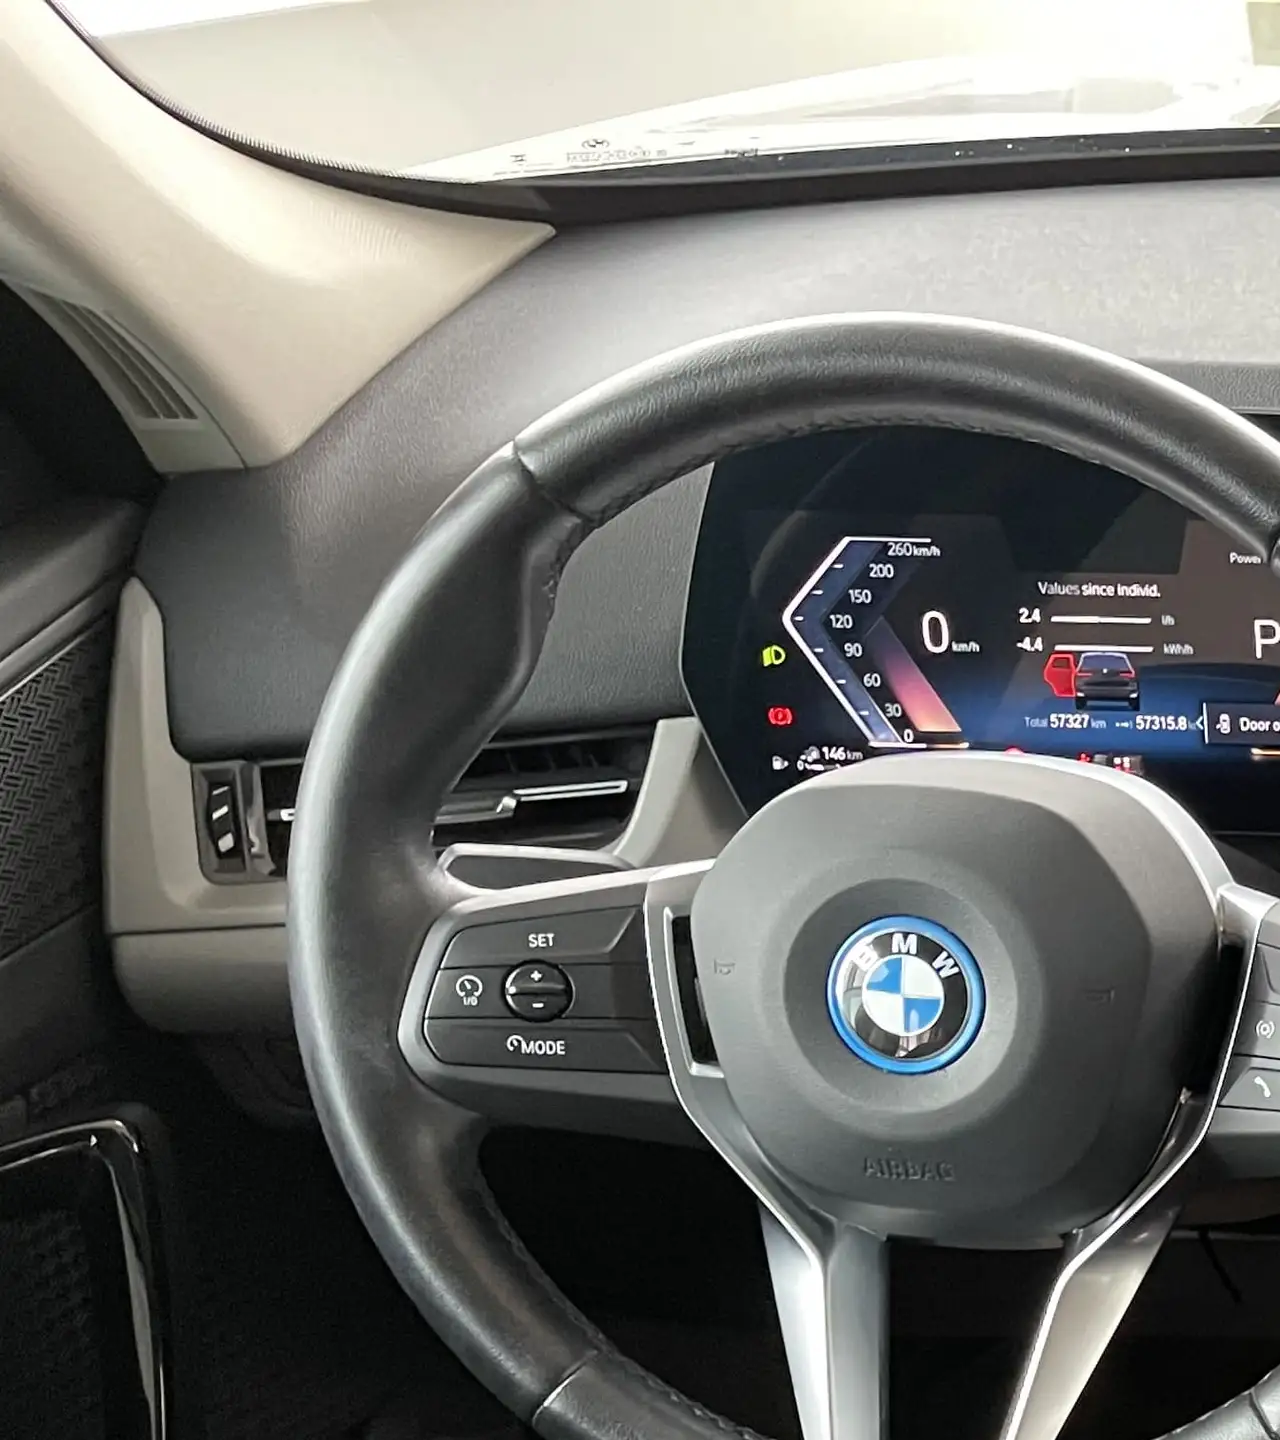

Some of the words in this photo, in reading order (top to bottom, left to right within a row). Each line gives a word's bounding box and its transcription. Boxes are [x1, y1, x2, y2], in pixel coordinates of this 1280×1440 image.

[869, 563, 894, 578] 200
[849, 589, 872, 603] 150
[1038, 581, 1080, 596] Values
[1081, 583, 1114, 597] since
[829, 614, 853, 628] 120
[1019, 607, 1041, 624] 2.4
[922, 610, 949, 654] 0
[952, 641, 980, 653] km/h
[1254, 619, 1280, 659] P
[844, 642, 862, 657] 90
[1016, 636, 1043, 652] -4.4
[863, 673, 881, 688] 60
[884, 703, 902, 718] 30
[1024, 716, 1048, 729] Total
[1050, 713, 1090, 729] 57327
[1091, 718, 1107, 729] km
[1136, 715, 1188, 731] 57315.8
[1239, 717, 1272, 732] Door
[903, 728, 914, 743] 0
[822, 746, 846, 761] 146
[847, 749, 863, 760] km
[528, 933, 555, 947] SET
[851, 932, 960, 980] BMW
[521, 1039, 566, 1056] MODE
[863, 1156, 956, 1182] AIRBAG
